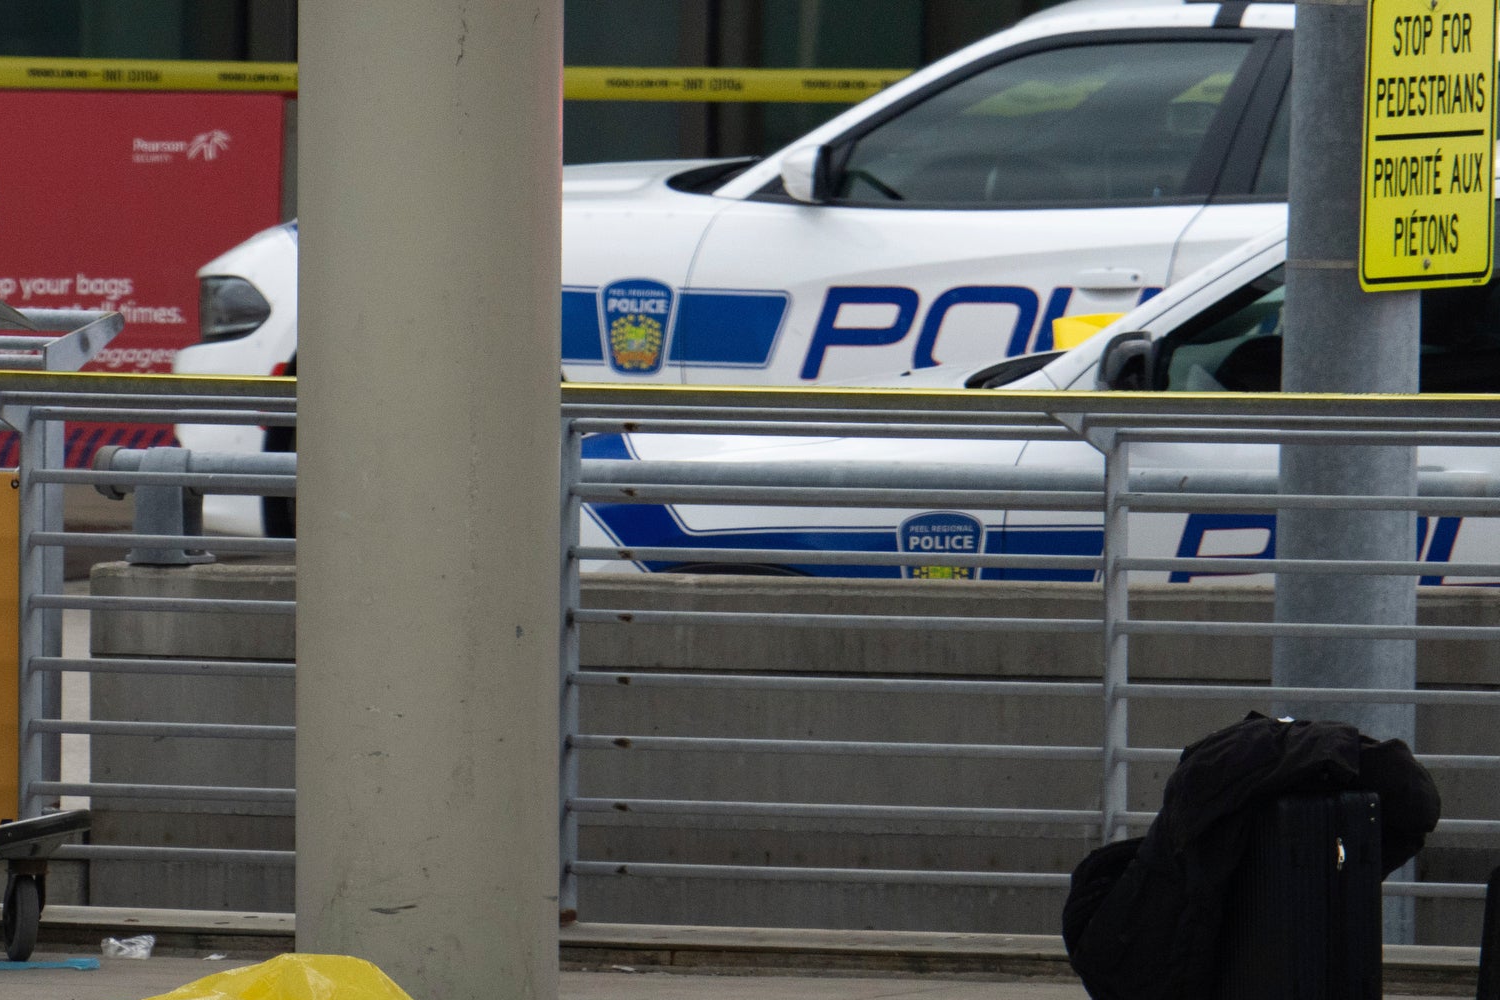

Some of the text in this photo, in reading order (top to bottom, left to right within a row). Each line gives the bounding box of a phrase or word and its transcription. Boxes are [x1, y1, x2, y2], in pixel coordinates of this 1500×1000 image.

[1393, 13, 1472, 56] STOP FOR
[1375, 72, 1485, 118] PEDESTRIANS
[1373, 149, 1483, 198] PRIORITÉ AUX
[1394, 210, 1459, 257] PIÉTONS
[19, 277, 73, 300] your
[76, 273, 133, 300] bags
[607, 298, 669, 313] POLICE
[909, 535, 974, 550] POLICE
